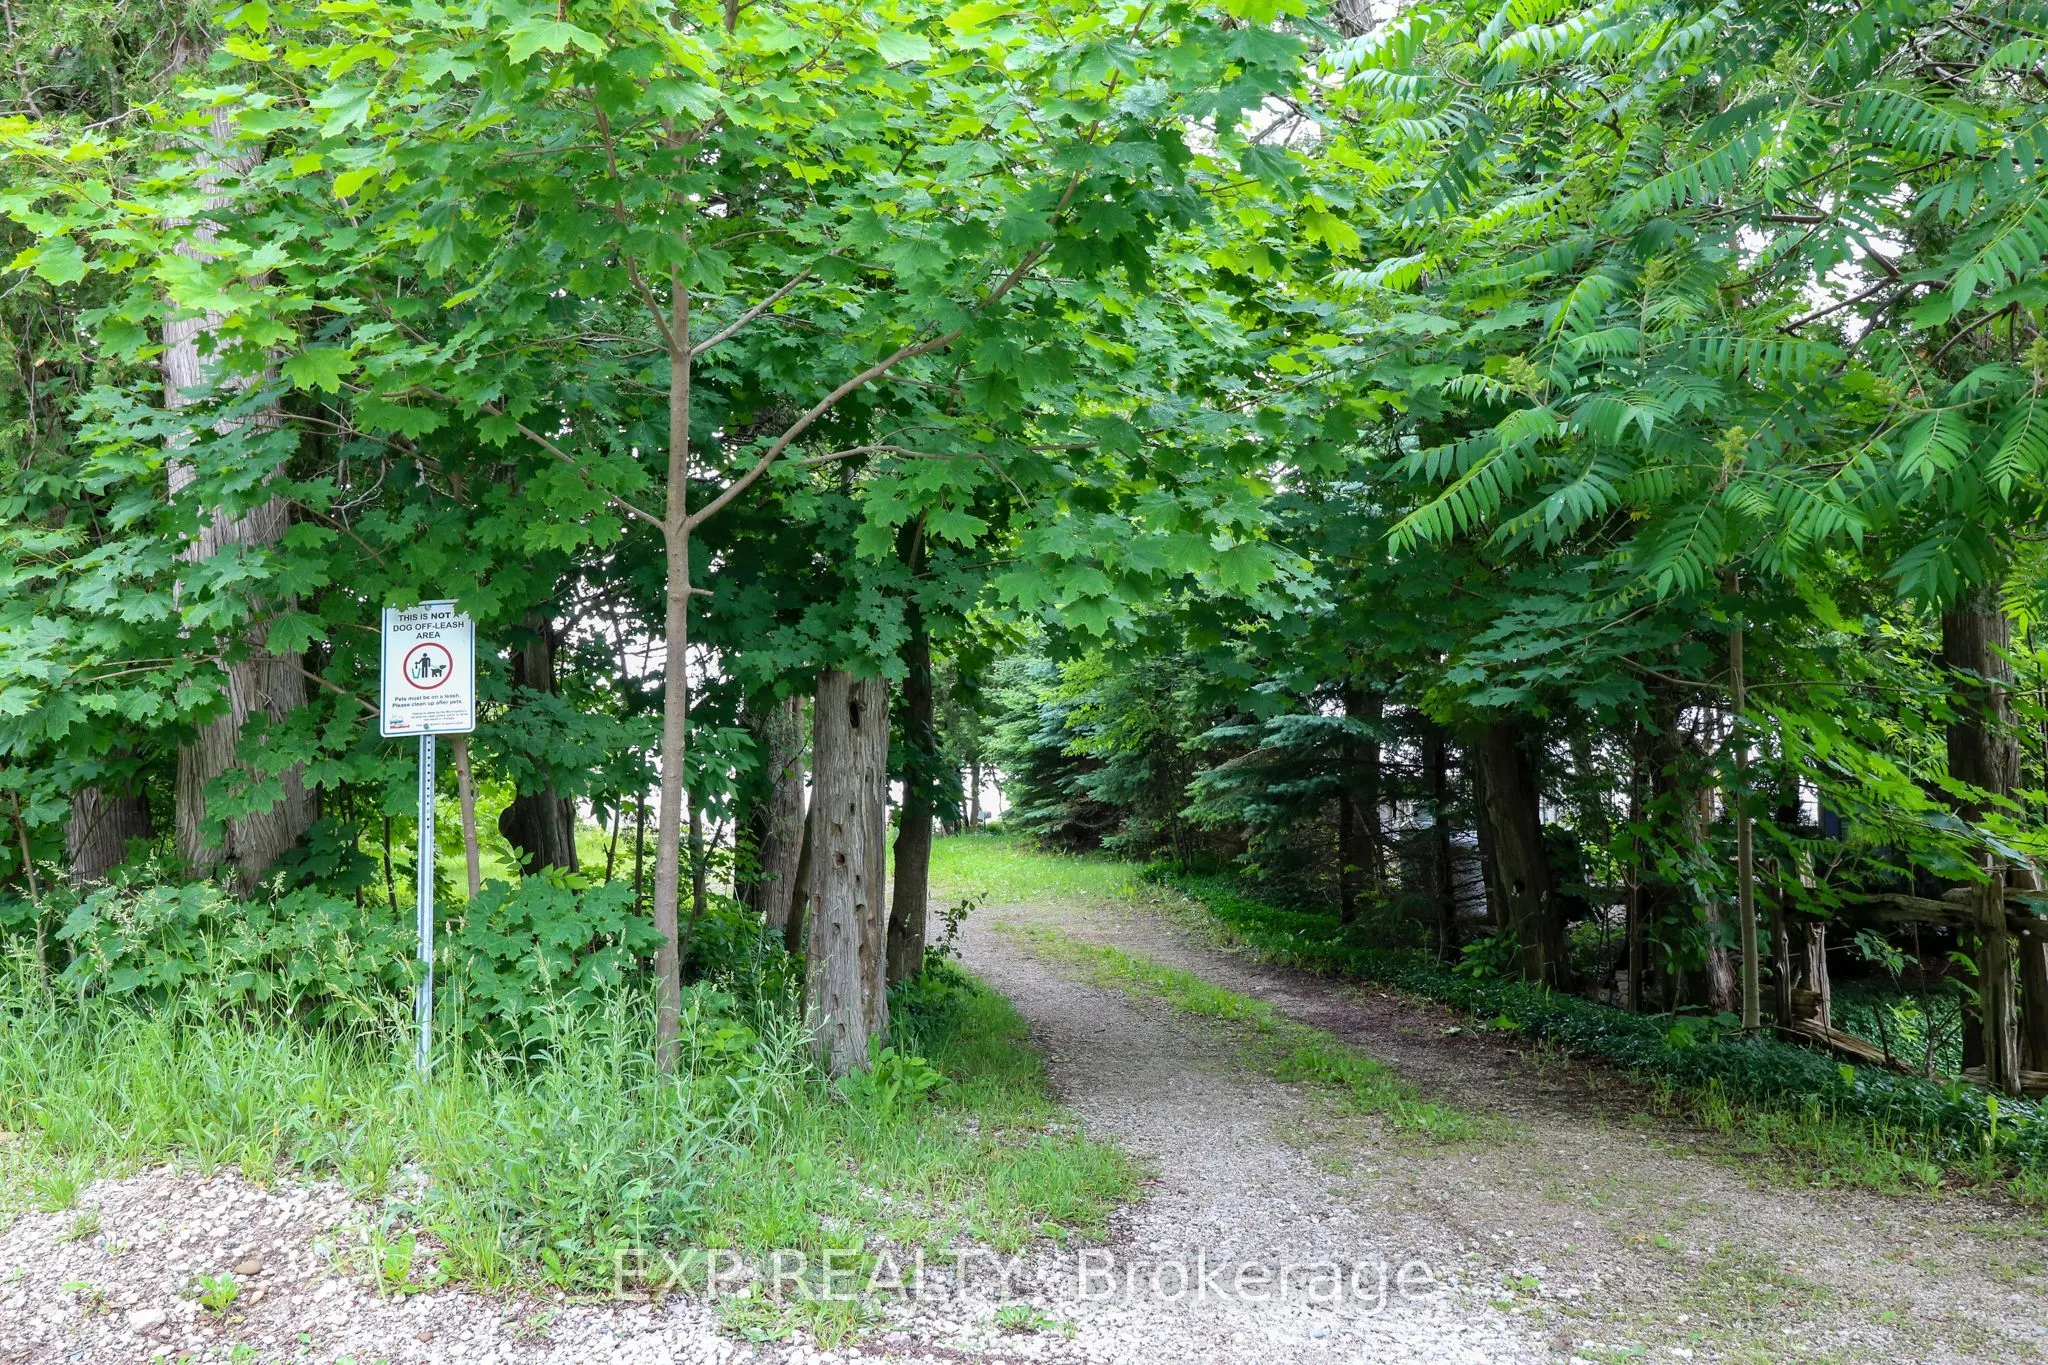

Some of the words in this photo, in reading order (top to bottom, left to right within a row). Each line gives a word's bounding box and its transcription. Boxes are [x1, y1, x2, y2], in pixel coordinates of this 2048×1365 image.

[393, 624, 413, 632] DOG
[415, 621, 464, 630] OFF-LEASH
[416, 631, 441, 639] AREA
